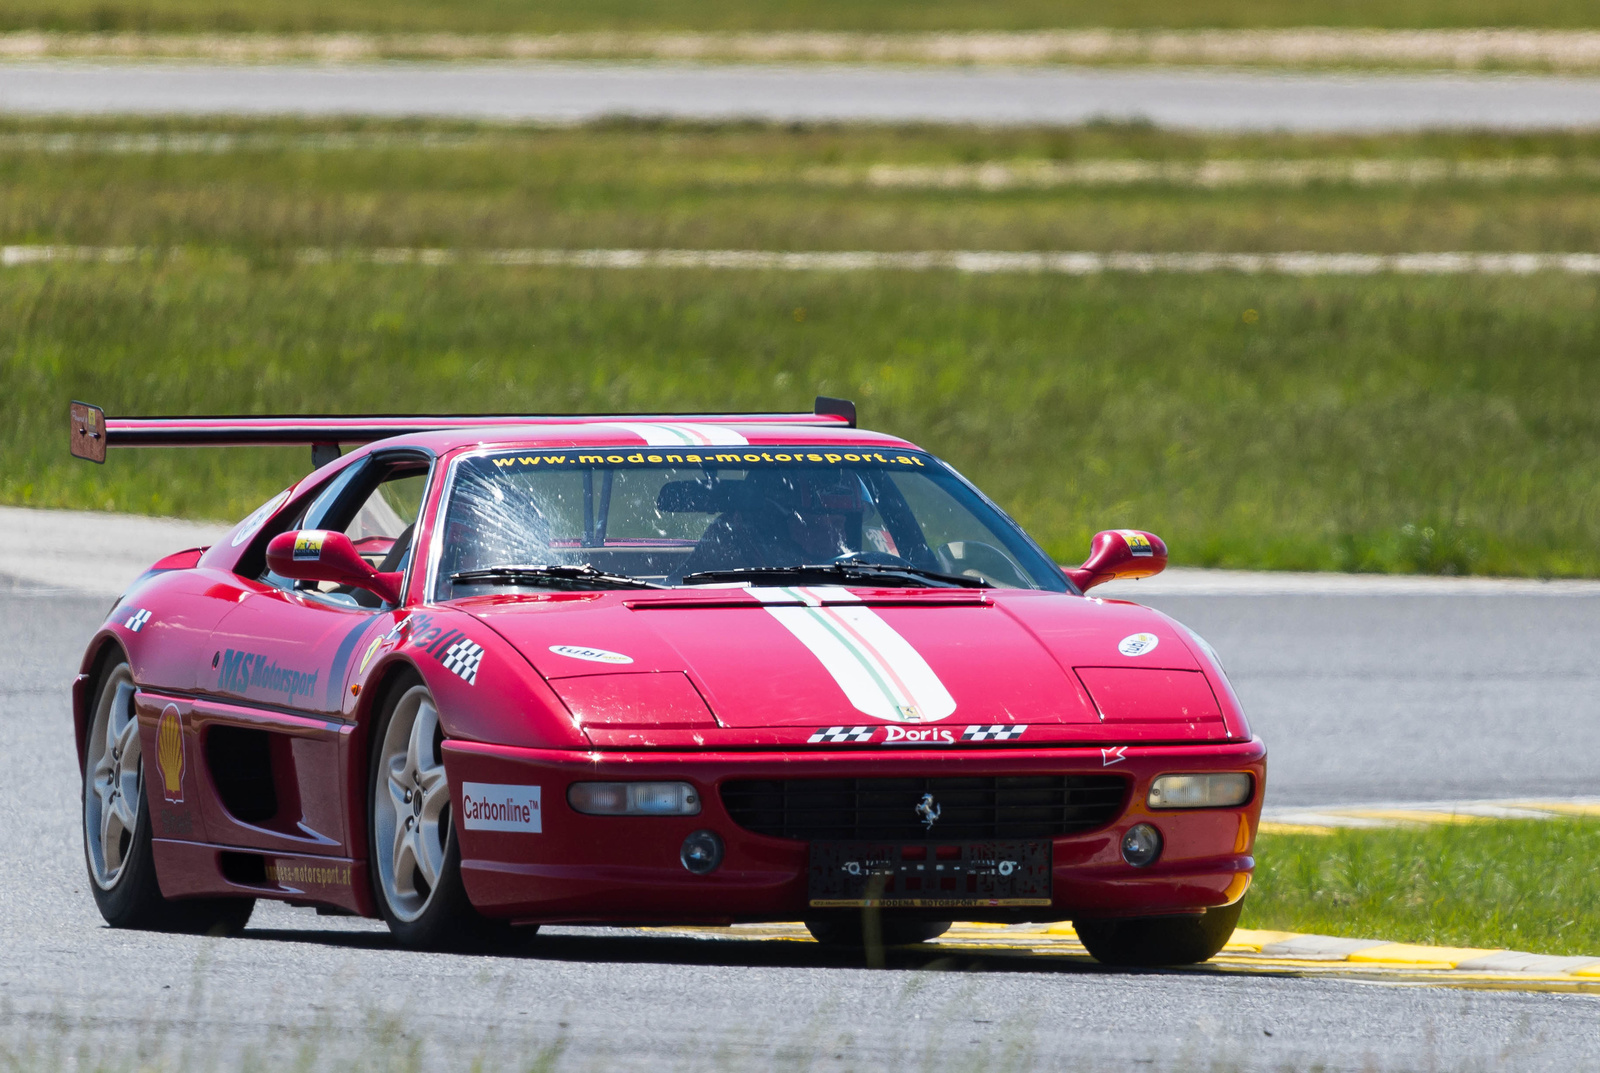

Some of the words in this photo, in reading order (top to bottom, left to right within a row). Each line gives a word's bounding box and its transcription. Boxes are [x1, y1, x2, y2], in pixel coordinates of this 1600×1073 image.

[492, 453, 925, 467] www.modena-motorsport.at
[218, 648, 255, 693] MS
[250, 654, 319, 703] Motorsport
[884, 725, 955, 744] Doris
